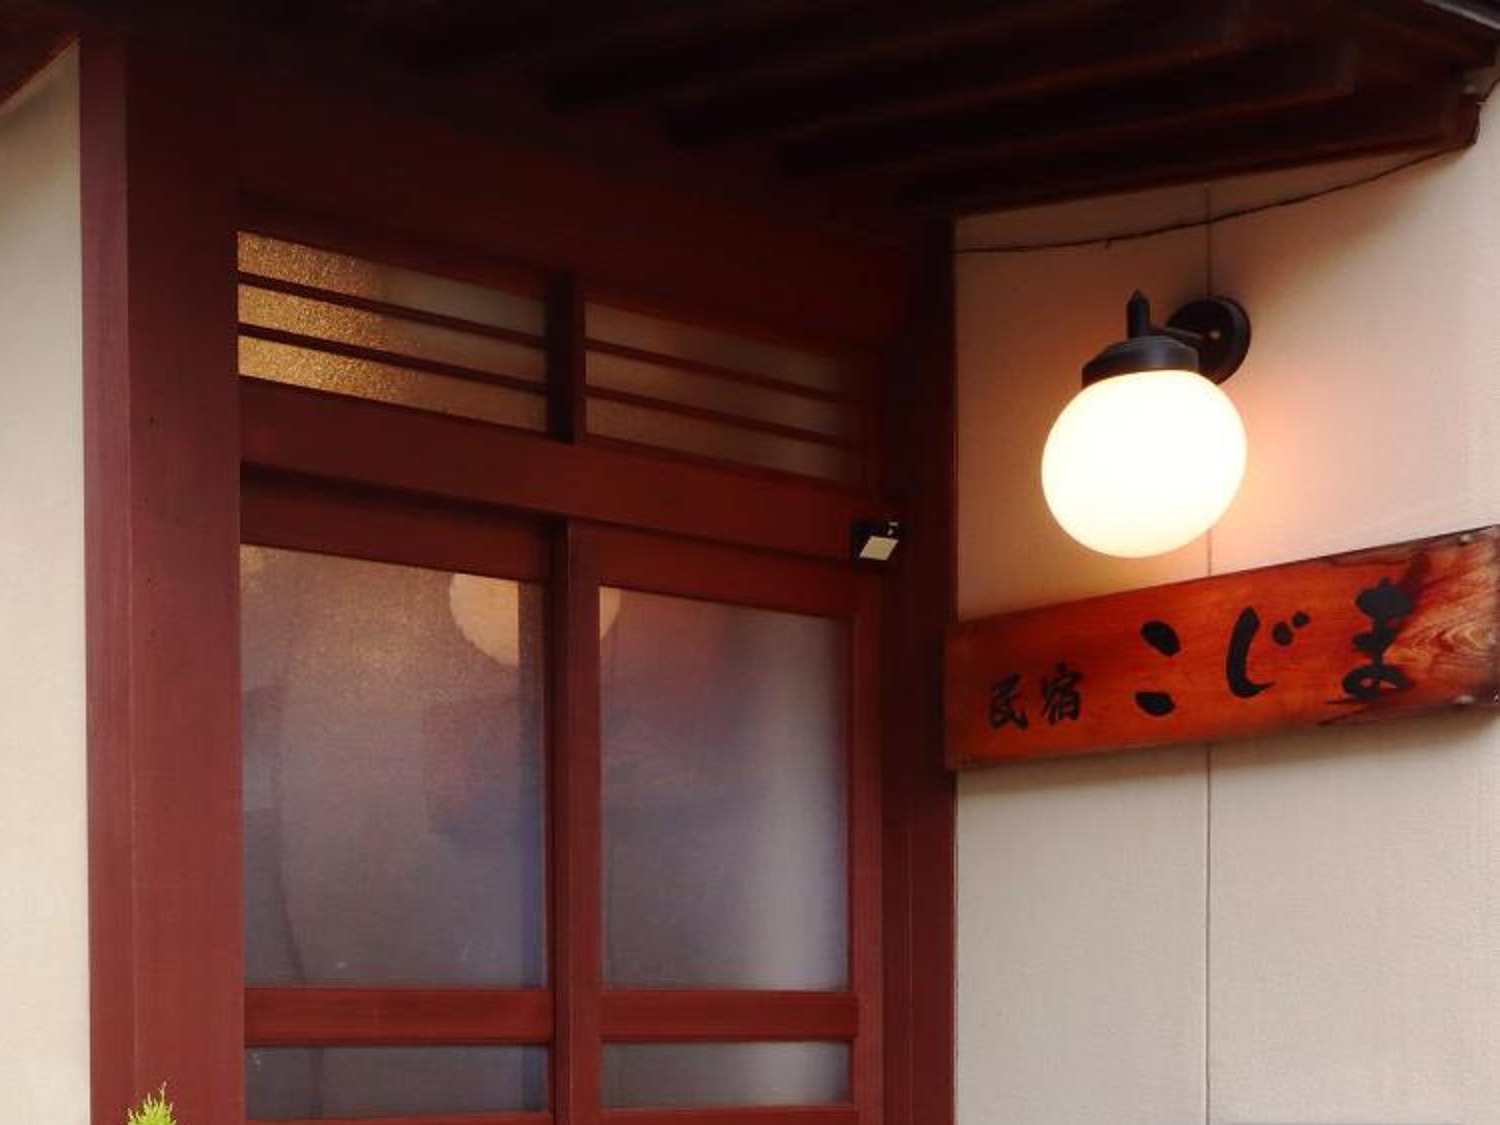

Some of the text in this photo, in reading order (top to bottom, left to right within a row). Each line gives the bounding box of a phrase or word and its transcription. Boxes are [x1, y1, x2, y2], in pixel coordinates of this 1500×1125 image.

[990, 576, 1414, 731] 民宿 こじま
